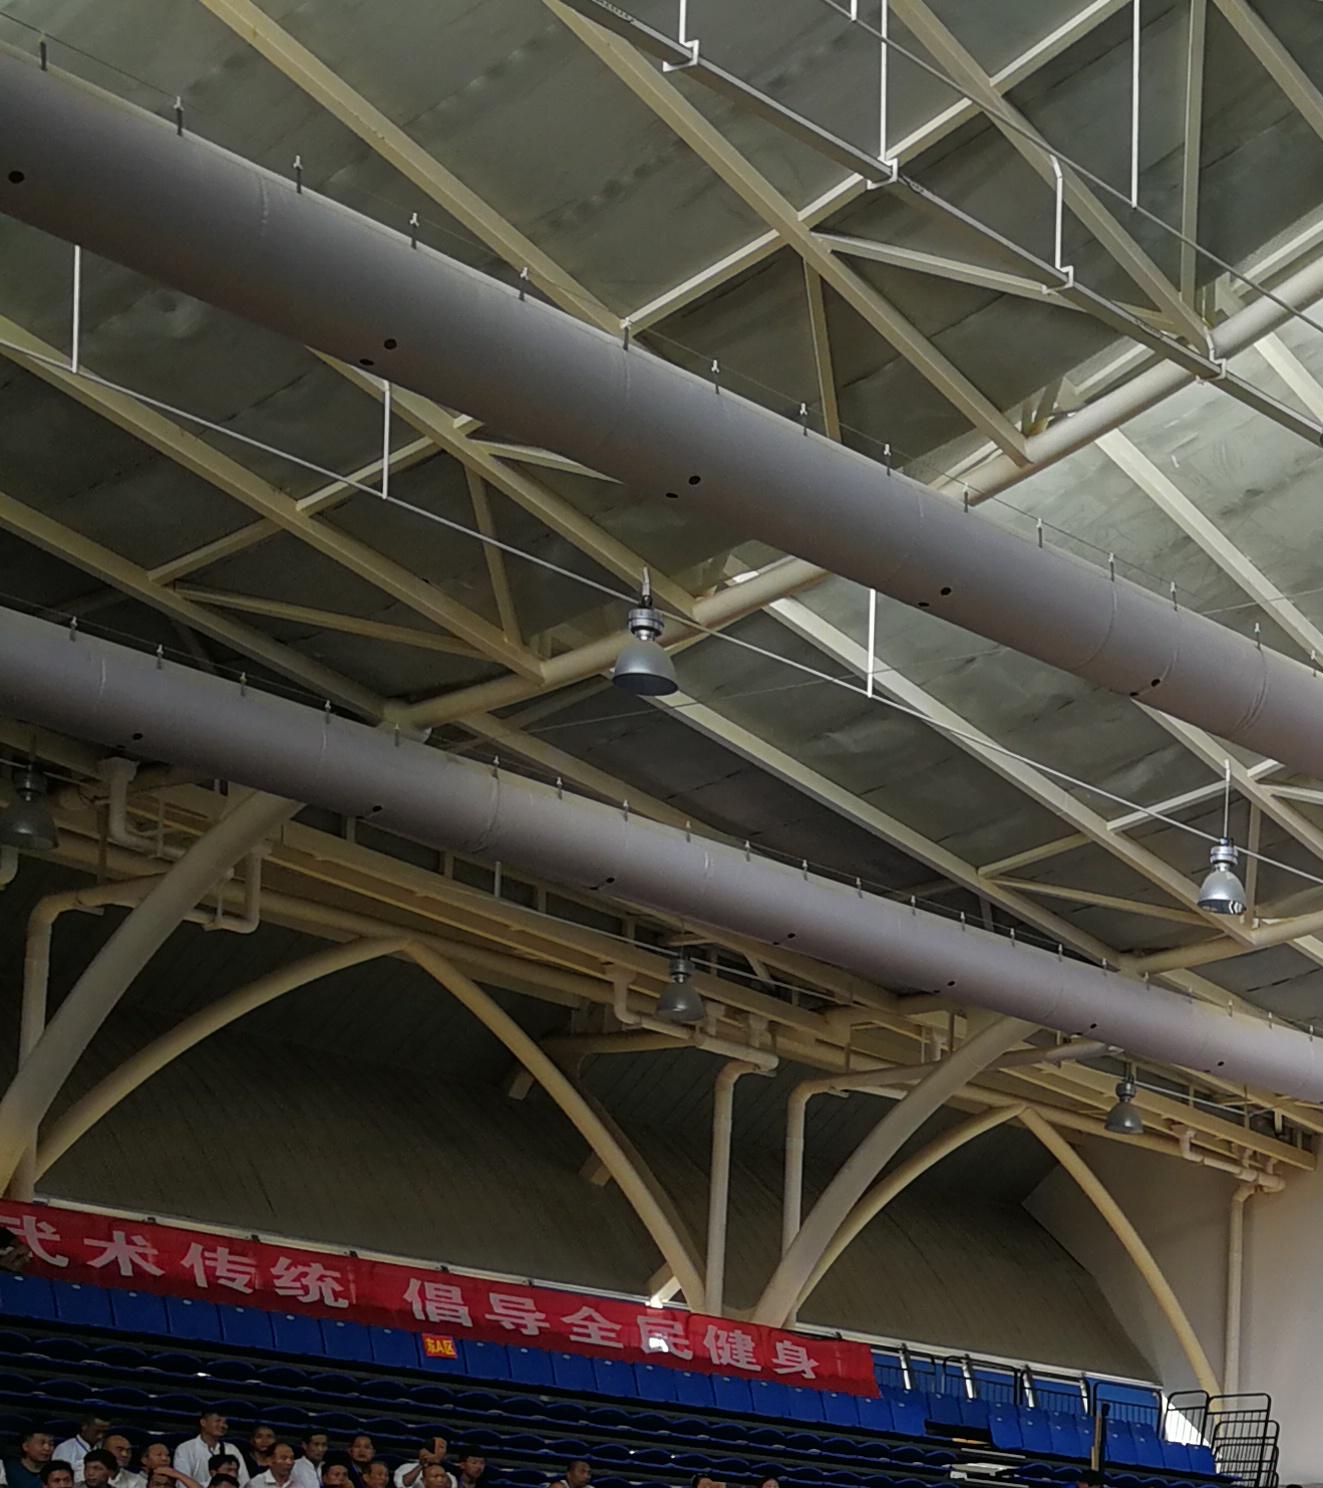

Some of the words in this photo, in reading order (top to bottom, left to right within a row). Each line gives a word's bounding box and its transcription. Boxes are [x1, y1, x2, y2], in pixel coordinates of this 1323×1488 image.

[404, 1278, 820, 1379] 倡导全民健身
